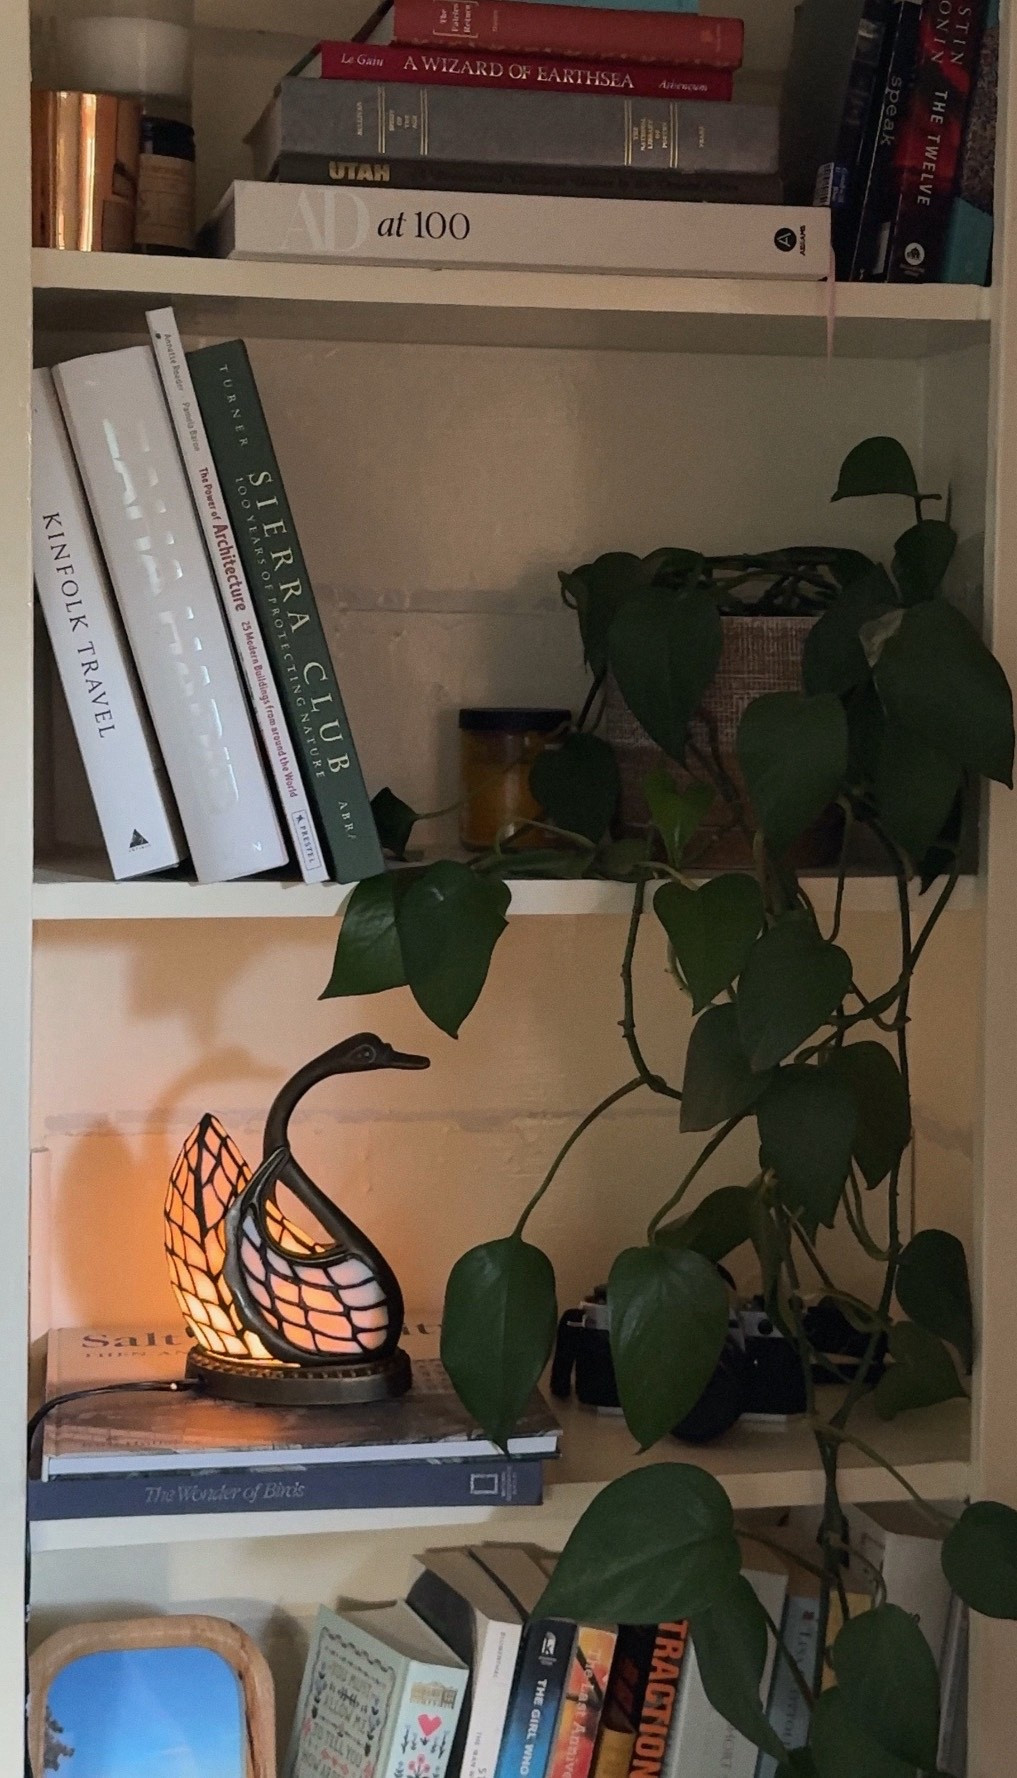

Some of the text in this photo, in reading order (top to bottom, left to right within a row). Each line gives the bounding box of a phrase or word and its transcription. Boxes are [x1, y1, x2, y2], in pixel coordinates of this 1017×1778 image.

[341, 53, 354, 65] Le
[403, 56, 635, 89] A WIZARD OF EARTHSEA
[880, 75, 902, 146] speak
[916, 90, 948, 207] THE TWELVE
[329, 160, 390, 182] UTAH
[281, 189, 471, 250] AD at 100
[219, 363, 249, 447] TURNER
[198, 466, 247, 612] The Power of Architecture
[42, 512, 115, 739] KINFOLK TRAVEL
[235, 476, 326, 779] 100 YEARS OF PROTECTING NATURE
[247, 471, 350, 773] SIERRA CLUB
[241, 621, 298, 798] 25 Modern Buildings from around the World
[300, 825, 316, 864] PRESTEL
[82, 1332, 183, 1348] Salt
[144, 1481, 305, 1503] The Wonder of Birds
[533, 1678, 548, 1706] THE
[576, 1683, 595, 1719] Last
[526, 1708, 541, 1740] GIRL
[520, 1743, 535, 1776] WHO
